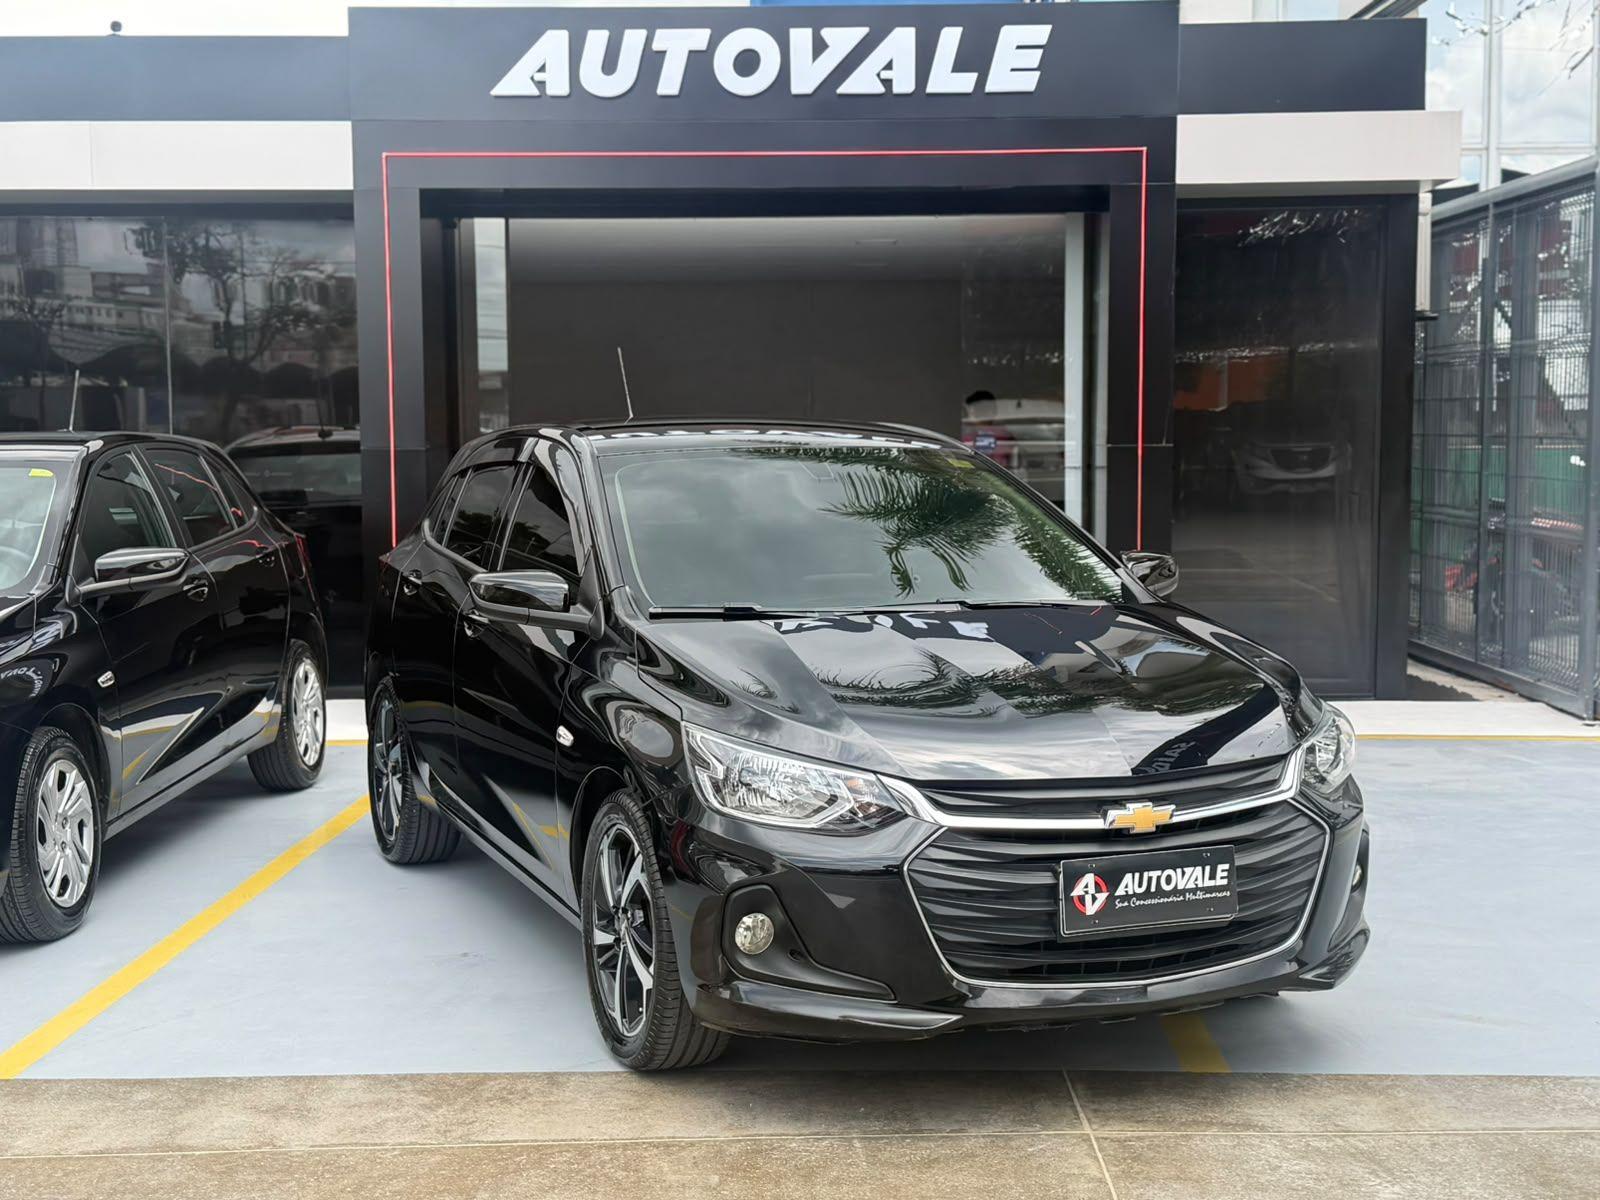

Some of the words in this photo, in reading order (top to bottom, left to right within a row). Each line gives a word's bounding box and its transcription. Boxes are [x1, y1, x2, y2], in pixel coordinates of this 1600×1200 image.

[490, 24, 1052, 98] AUTOVALE
[1114, 863, 1230, 897] AUTOVALE
[1114, 899, 1129, 909] Sua
[1185, 889, 1231, 901] Multimarcas
